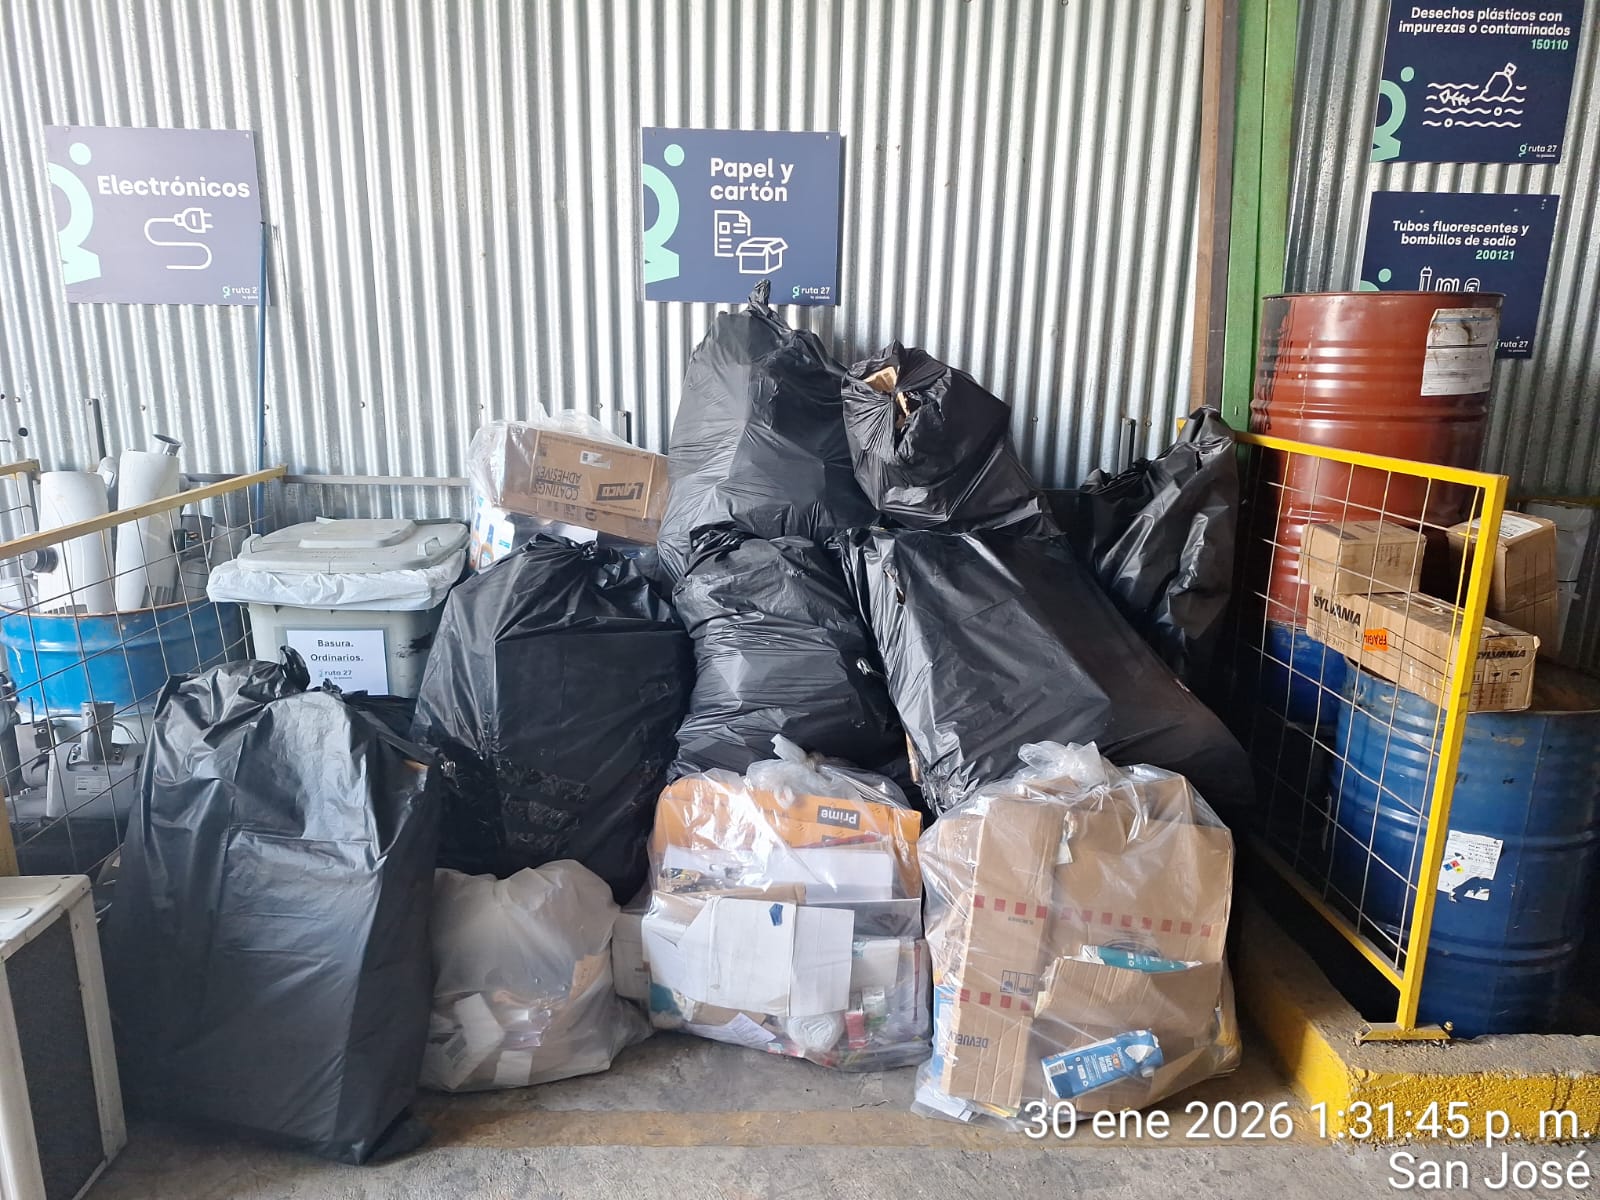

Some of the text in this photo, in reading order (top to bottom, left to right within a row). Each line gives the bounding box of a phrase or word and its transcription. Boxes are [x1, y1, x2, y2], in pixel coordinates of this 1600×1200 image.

[1411, 7, 1563, 23] Desechos plásticos con
[1398, 21, 1571, 36] impurezas o contaminados
[1531, 39, 1569, 50] 150110
[1528, 145, 1545, 153] ruta
[1547, 145, 1558, 153] 27
[710, 157, 794, 184] Papel y
[97, 174, 250, 198] Electrónicos
[710, 181, 788, 202] cartón
[1393, 220, 1530, 237] Tubos fluorescentes y
[1401, 233, 1517, 247] bombillos de sodio
[1475, 250, 1515, 260] 200121
[232, 286, 250, 294] ruta
[801, 286, 819, 295] ruta
[820, 286, 831, 295] 27
[1500, 340, 1529, 348] ruta 27
[535, 466, 582, 486] ADHESIVES
[534, 483, 579, 501] COATINGS
[601, 482, 640, 500] LANCO
[1313, 595, 1362, 627] SYLVANIA
[317, 639, 354, 647] Basura.
[310, 653, 364, 662] Ordinarios.
[821, 809, 858, 825] Prime
